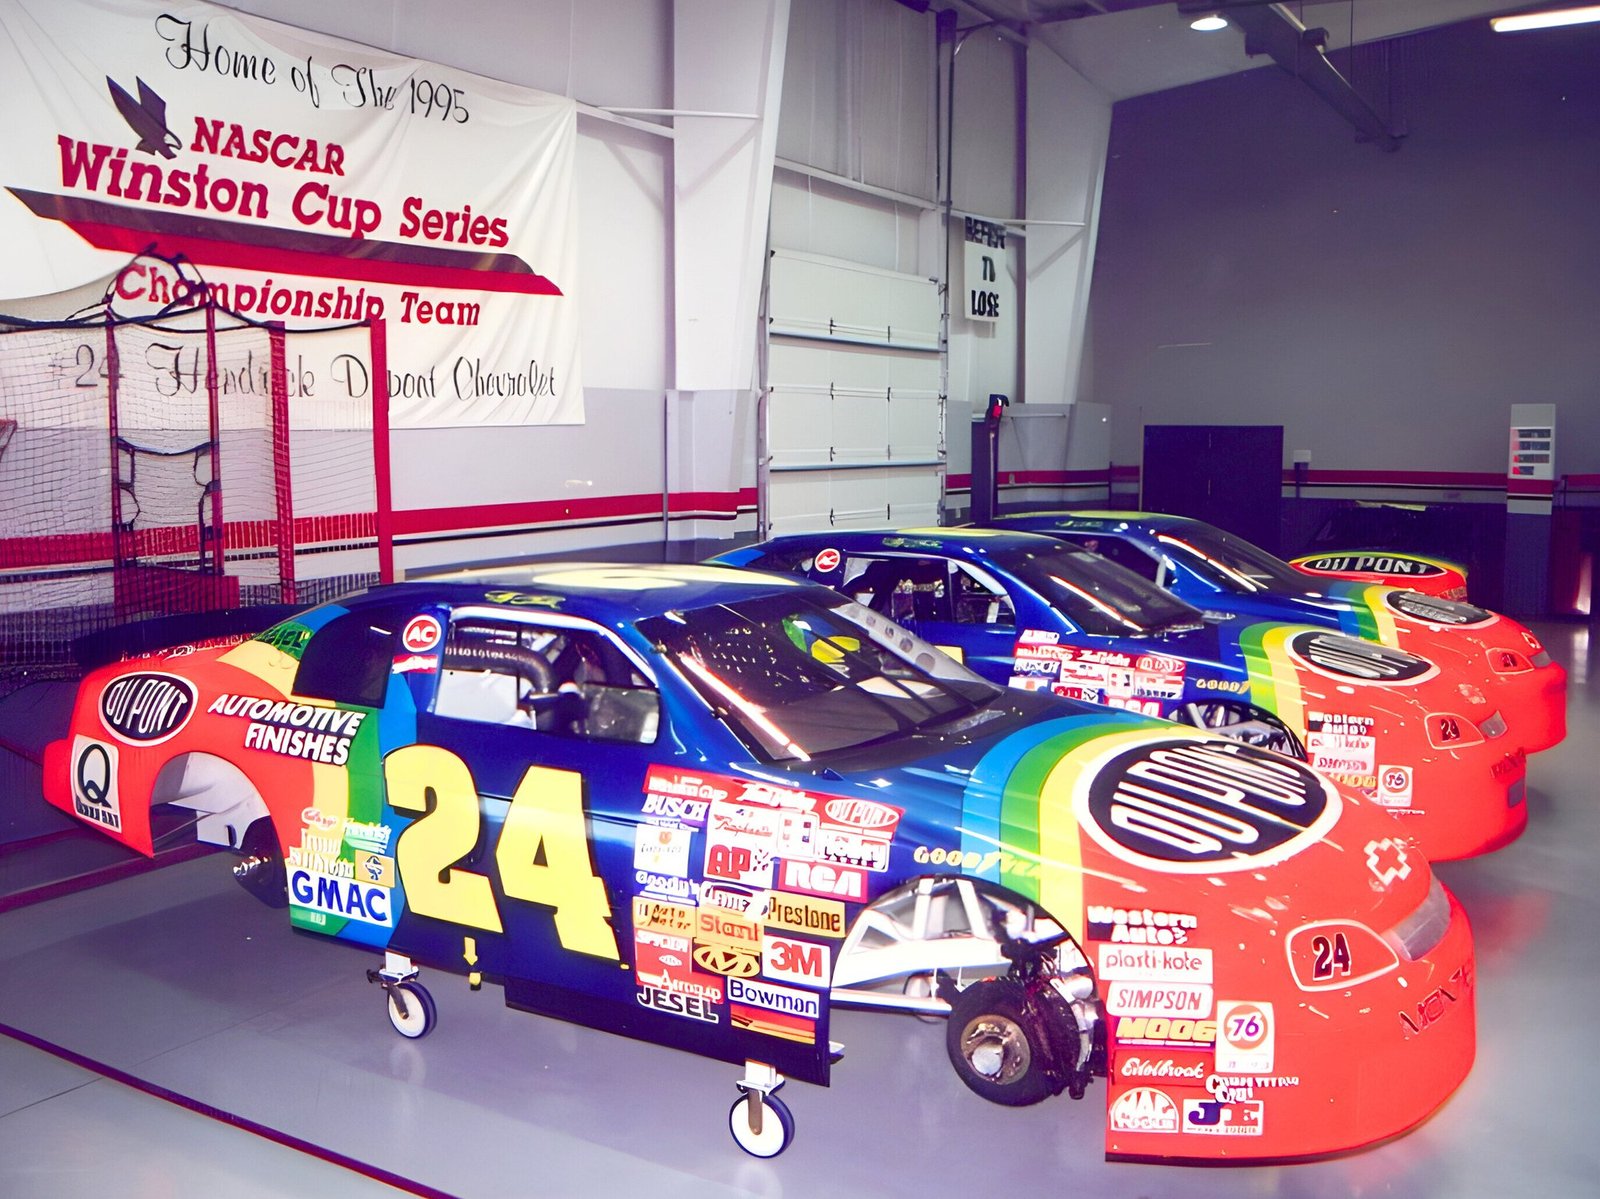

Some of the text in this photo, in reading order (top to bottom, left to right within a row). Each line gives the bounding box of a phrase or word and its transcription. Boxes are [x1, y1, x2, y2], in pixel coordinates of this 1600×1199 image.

[155, 13, 470, 123] Home of The 1995
[190, 115, 346, 177] NASCAR
[57, 133, 510, 248] Winston Cup Series
[114, 262, 481, 326] Championship Team
[971, 290, 999, 317] LOSE
[407, 626, 437, 643] AC
[207, 693, 367, 737] AUTOMOTIVE
[244, 723, 351, 766] FINISHES
[383, 743, 621, 962] 24
[706, 844, 750, 880] AP
[292, 869, 388, 922] GMAC
[785, 861, 862, 897] RCA
[767, 896, 841, 932] Prestone
[770, 941, 822, 978] 3M
[1312, 932, 1352, 981] 24
[637, 984, 719, 1023] JESEL
[729, 979, 818, 1016] Bowman
[1116, 988, 1203, 1011] SIMPSON
[1115, 1017, 1217, 1041] MOOG
[1232, 1015, 1260, 1037] 76
